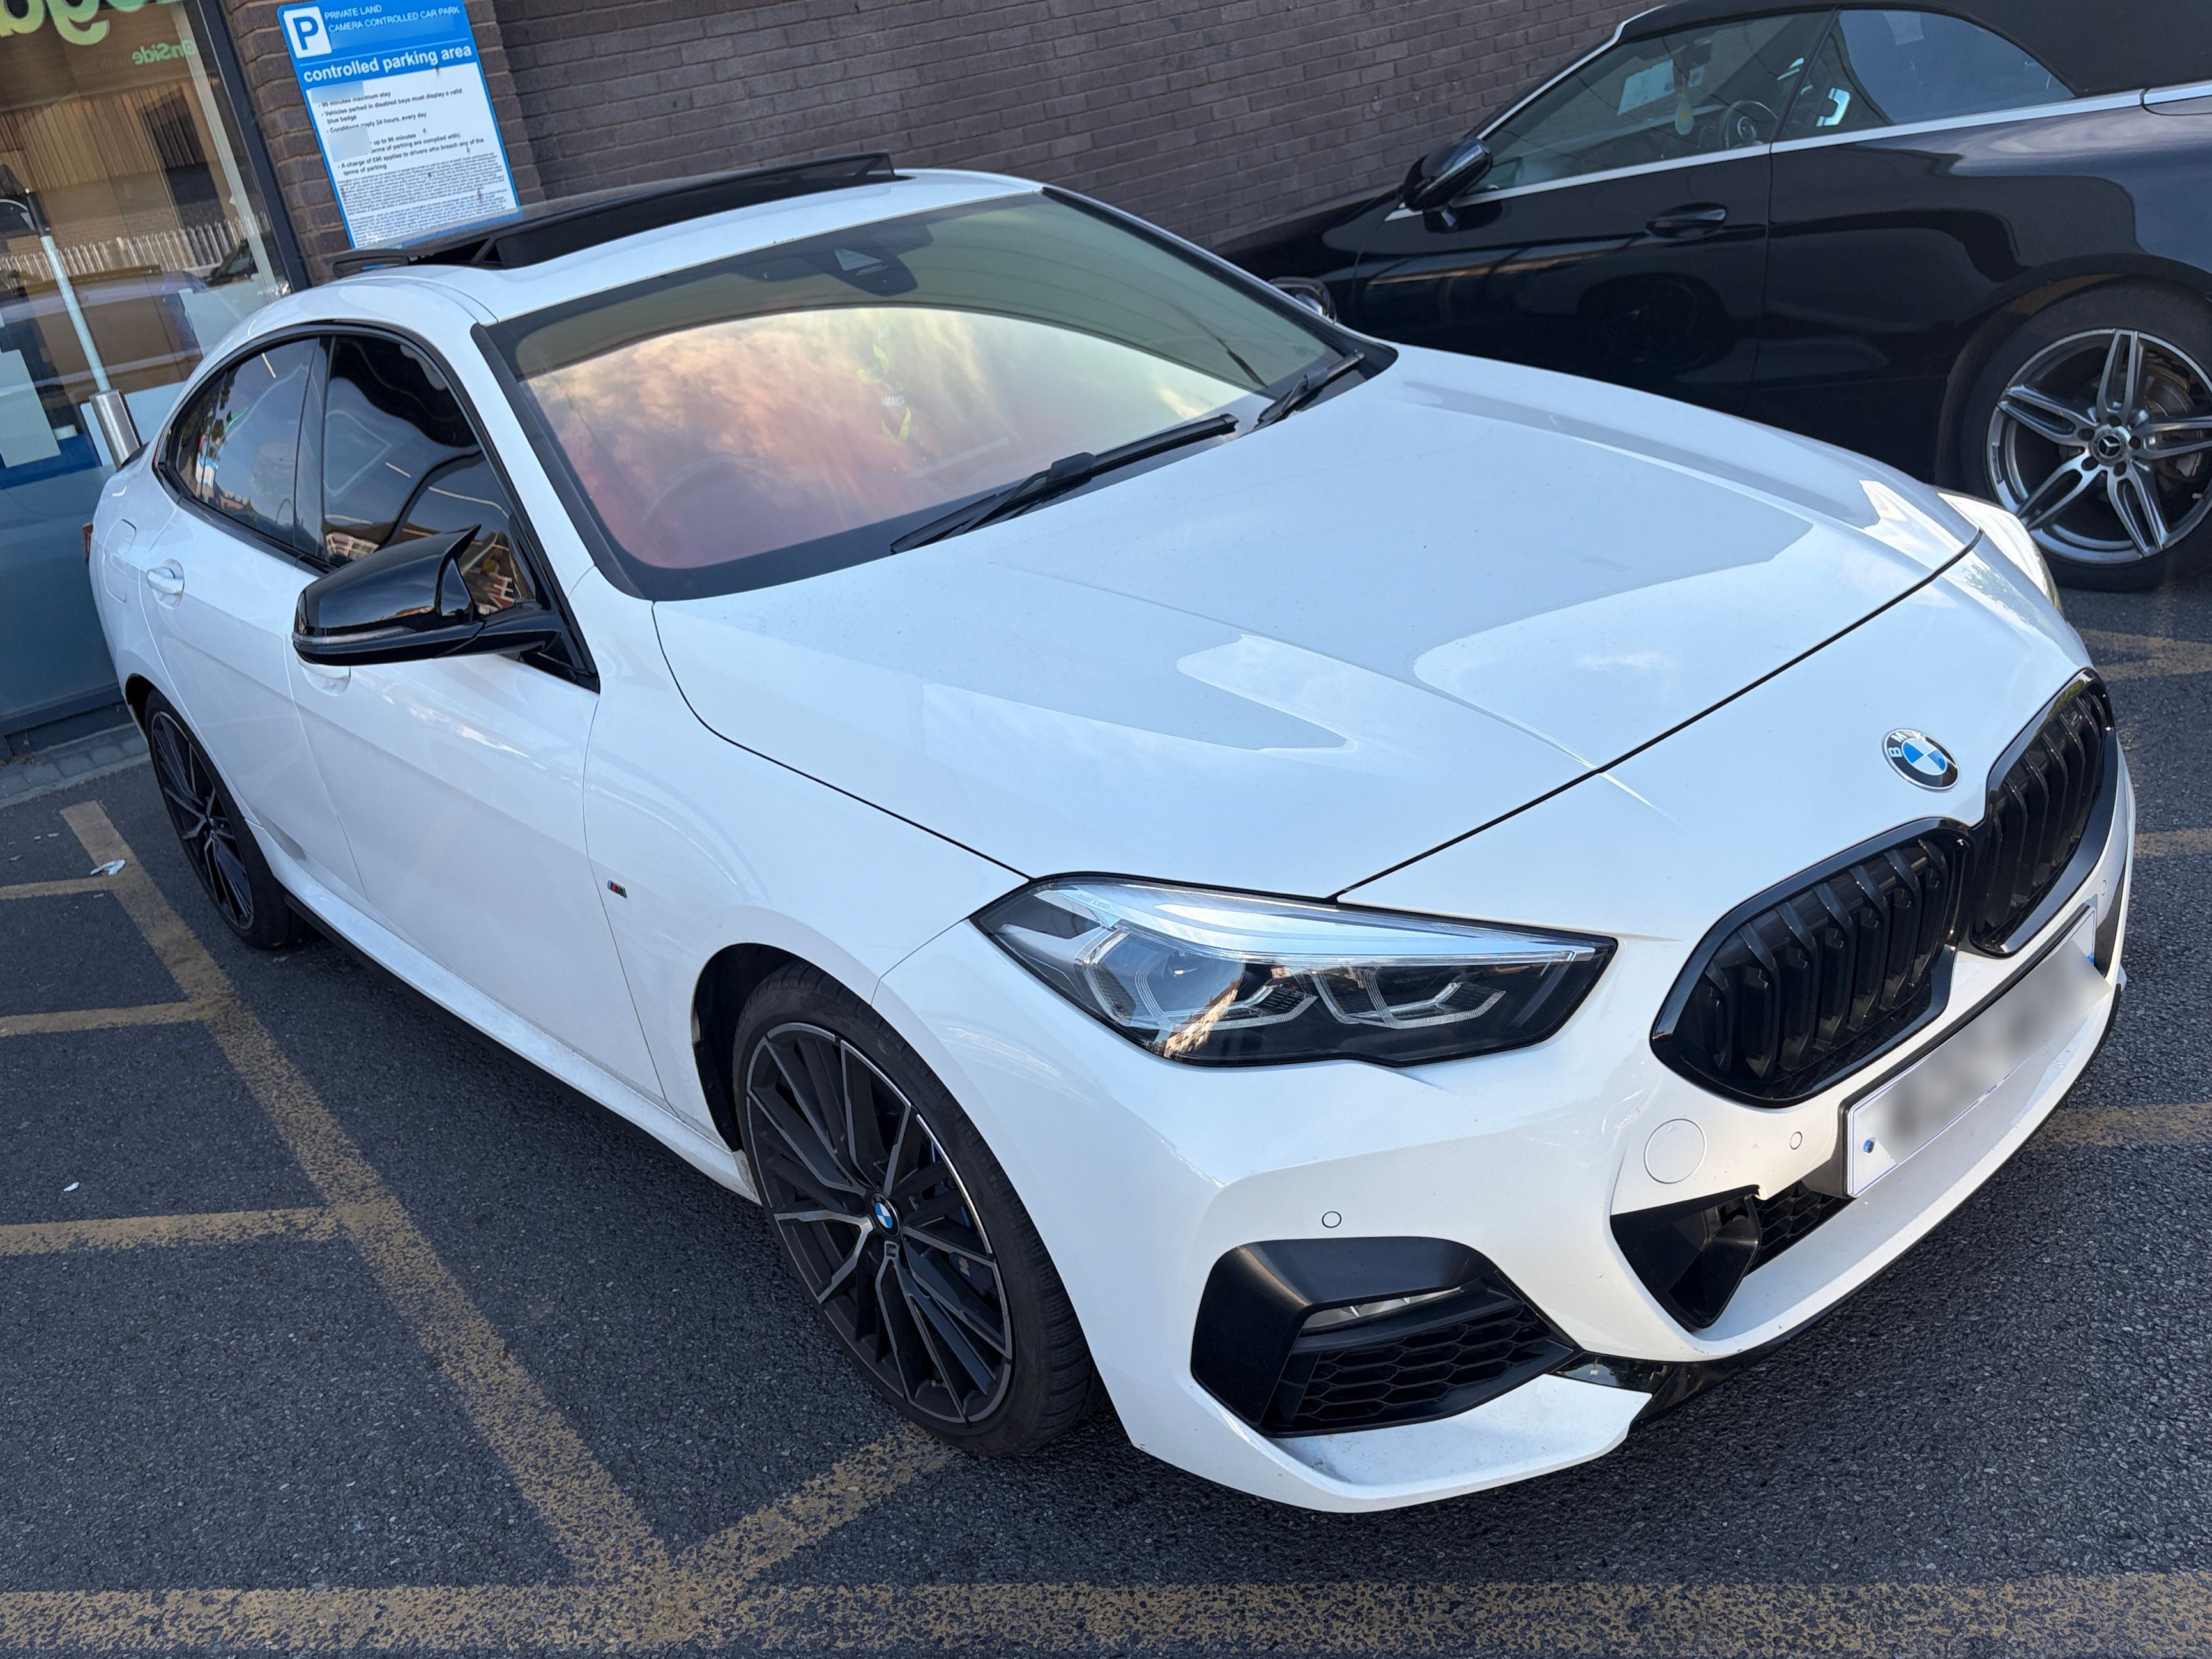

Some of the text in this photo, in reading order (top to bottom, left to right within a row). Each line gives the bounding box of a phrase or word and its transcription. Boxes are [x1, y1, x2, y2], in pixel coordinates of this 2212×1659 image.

[324, 4, 383, 20] PRIVATE LAND
[328, 6, 460, 33] CAMERA CONTROLLED CAR PARK
[293, 16, 319, 50] P
[303, 45, 472, 83] controlled parking area
[349, 105, 367, 114] parked
[393, 142, 413, 150] parking
[367, 164, 387, 172] parking
[1078, 894, 1110, 908] BMW LED
